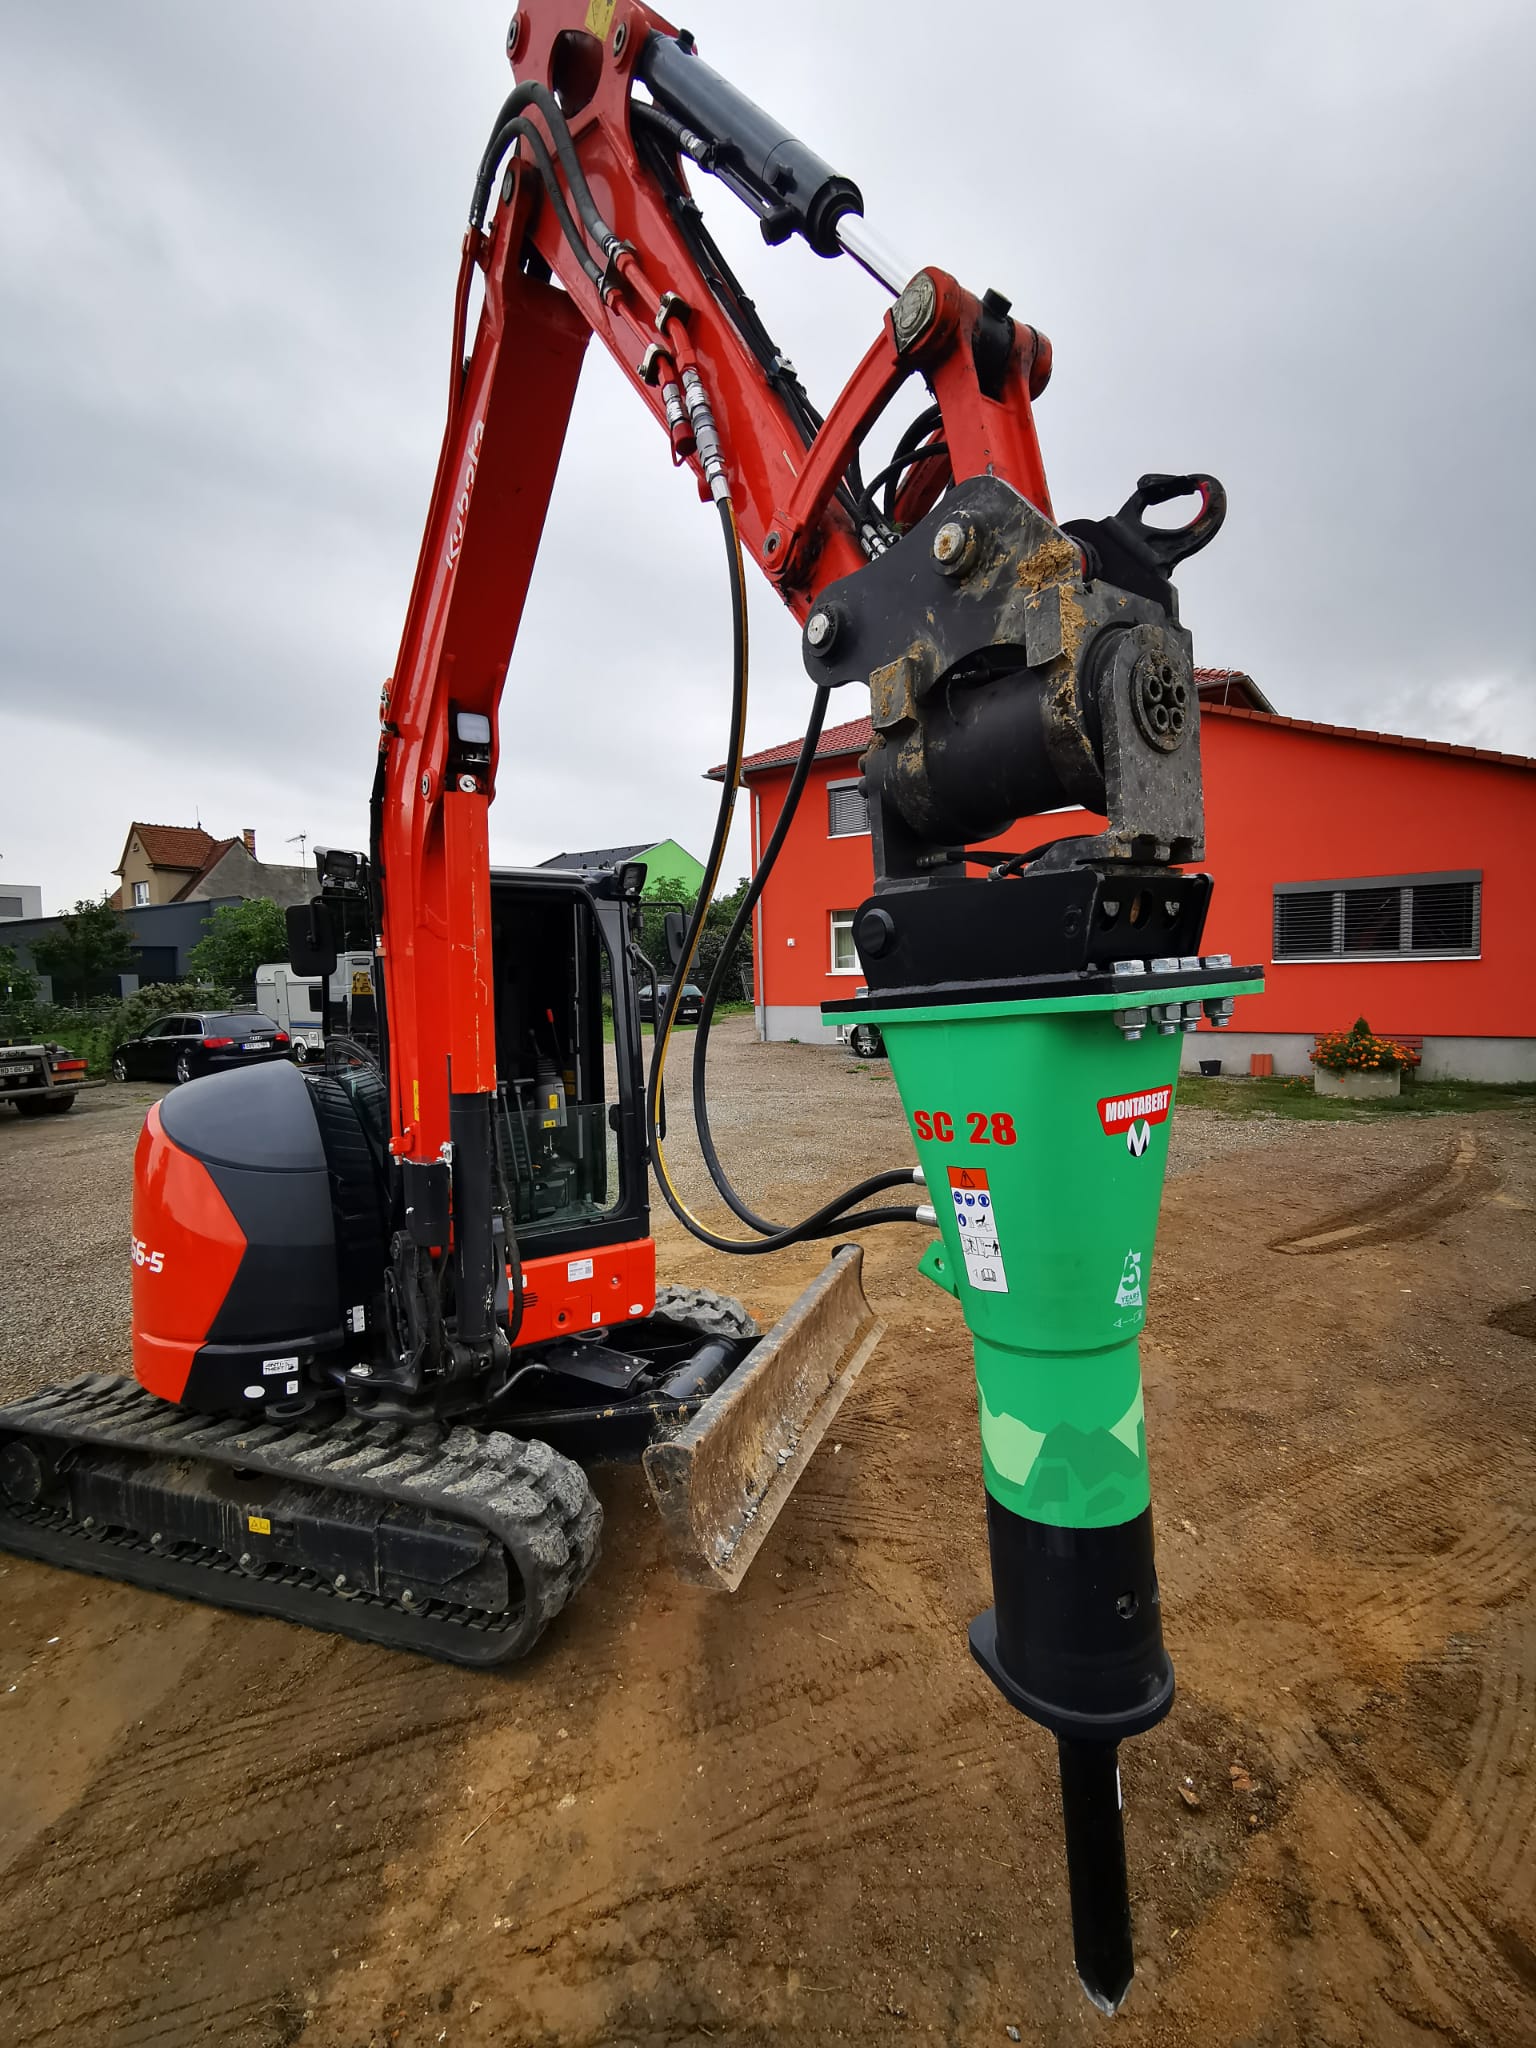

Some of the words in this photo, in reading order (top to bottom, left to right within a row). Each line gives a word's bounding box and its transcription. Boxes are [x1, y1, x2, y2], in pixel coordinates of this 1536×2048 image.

[1105, 1089, 1169, 1123] MONTABERT
[913, 1110, 955, 1143] SC
[966, 1112, 1017, 1146] 28
